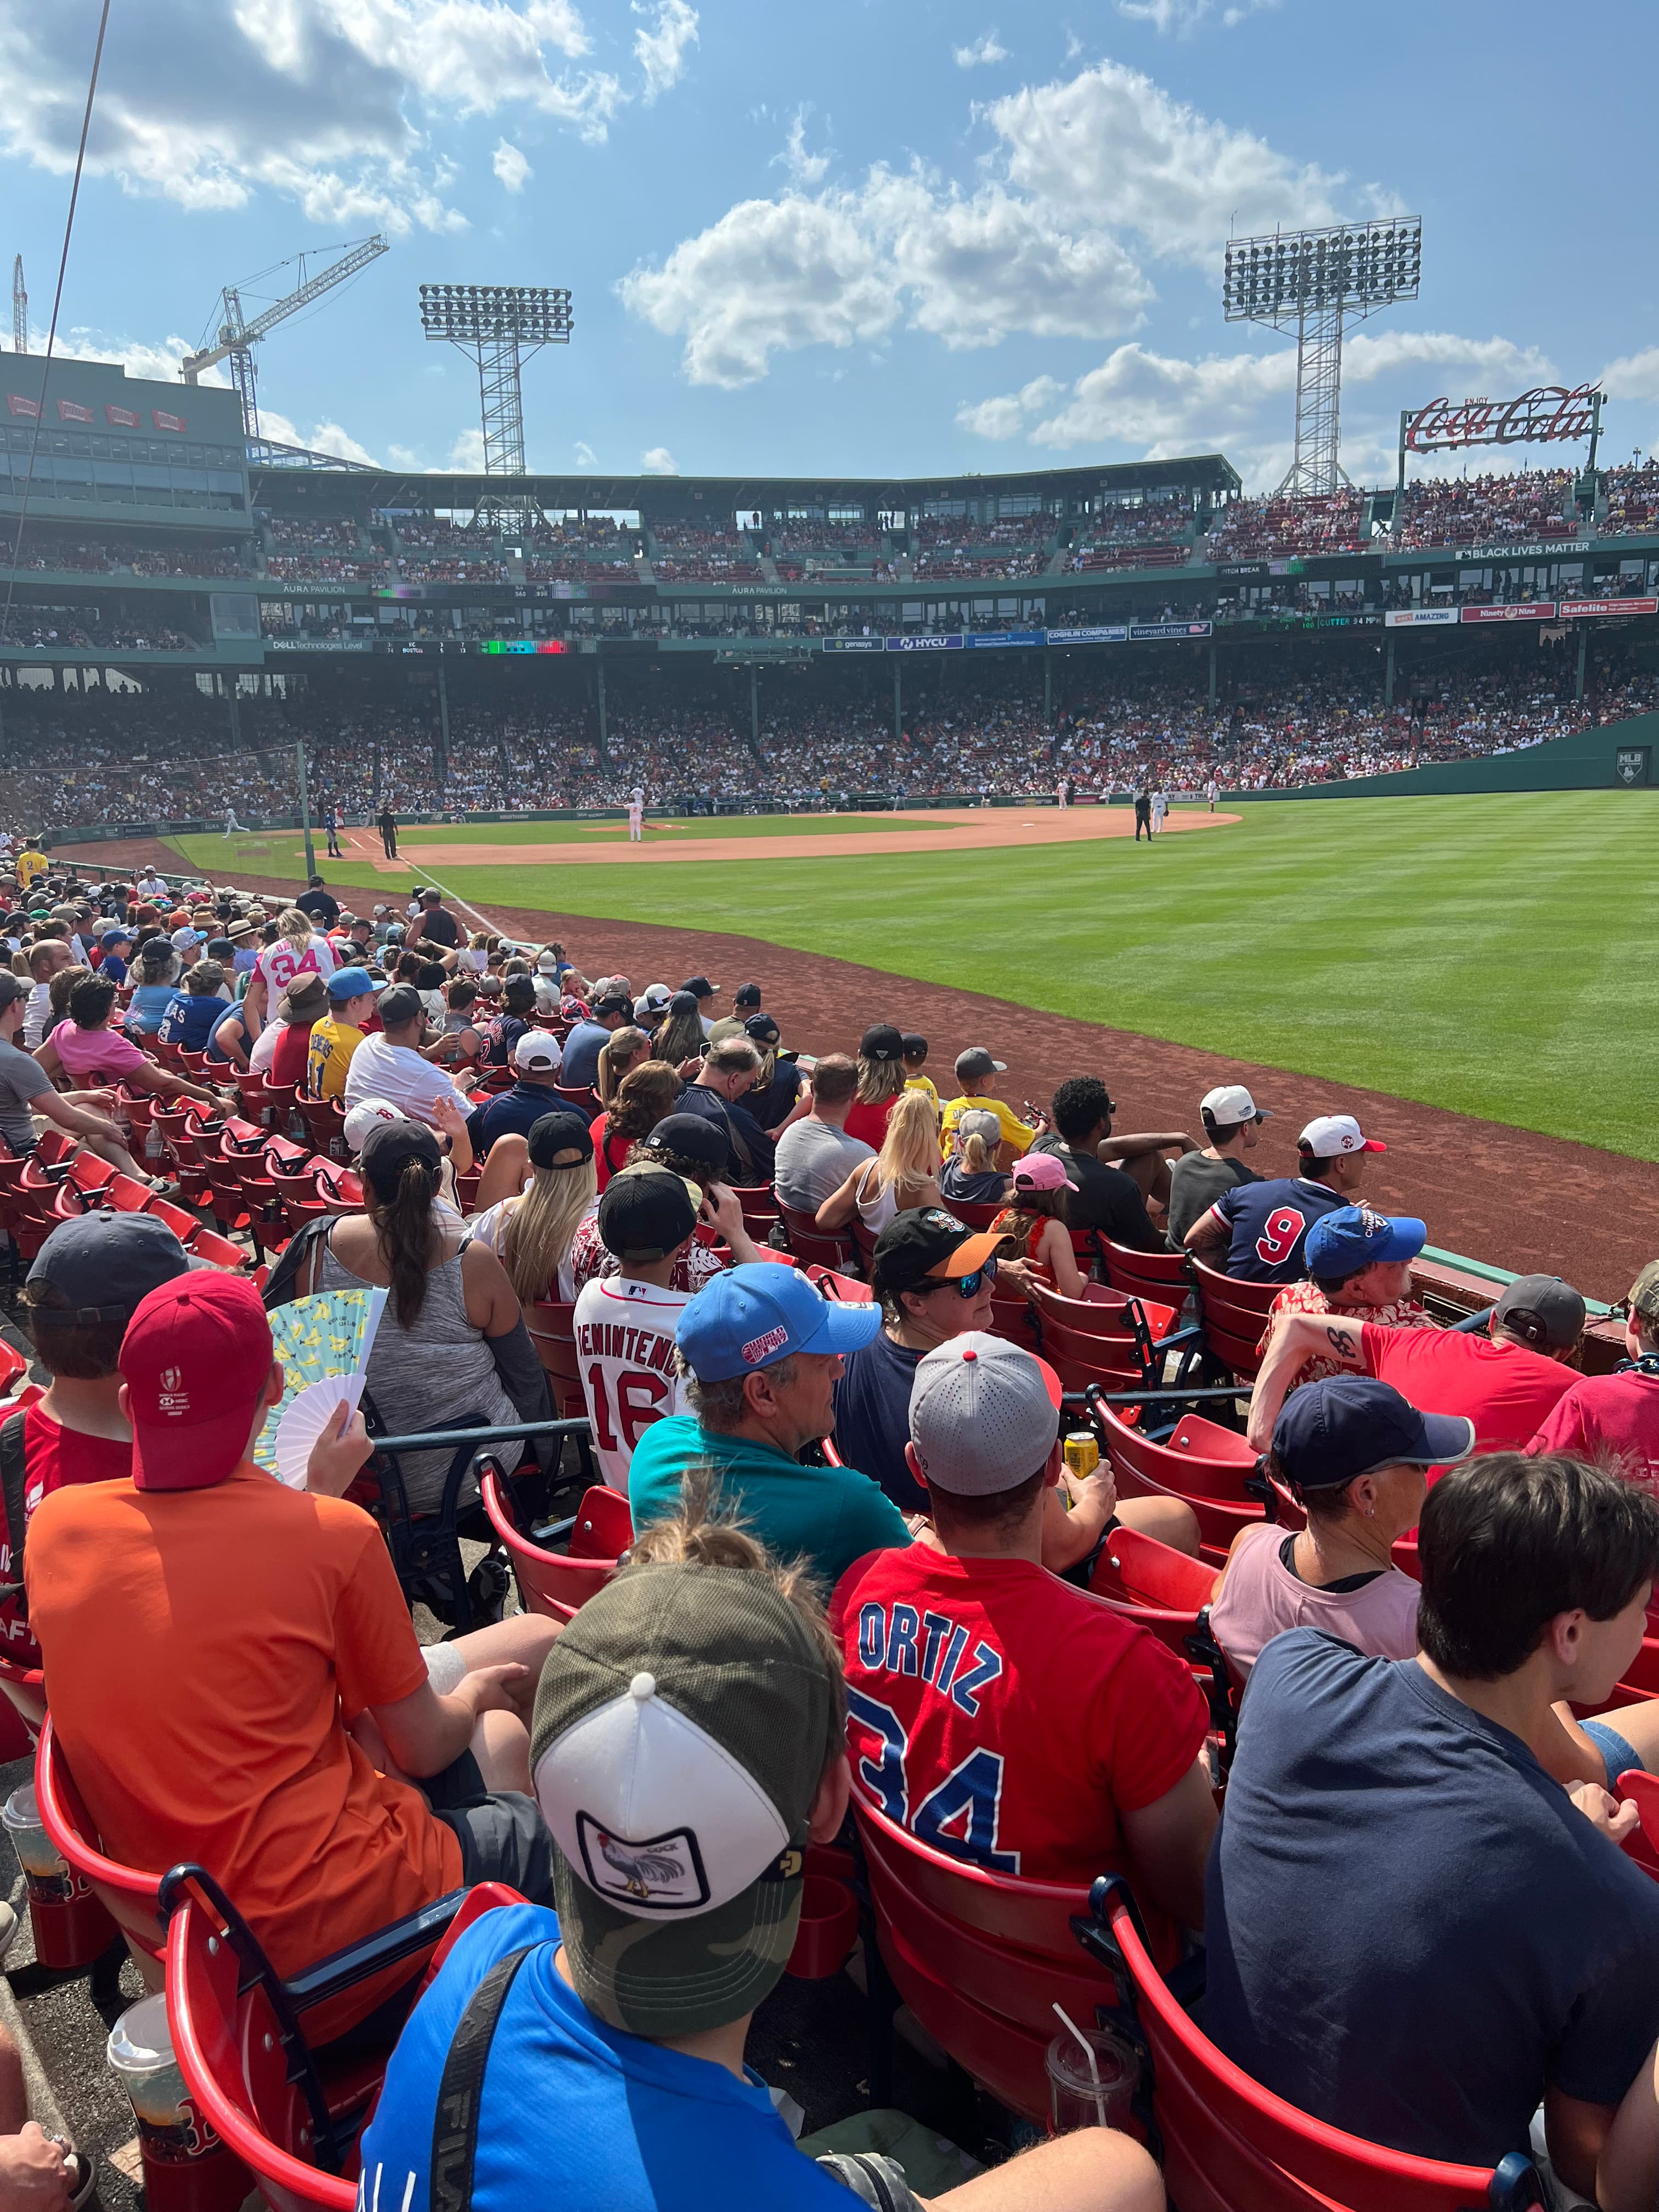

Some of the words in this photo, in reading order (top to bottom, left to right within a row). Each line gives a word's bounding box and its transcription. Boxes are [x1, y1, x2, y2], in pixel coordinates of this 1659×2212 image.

[1464, 397, 1488, 407] ENJOY
[1472, 548, 1509, 558] BLACK
[1511, 545, 1543, 556] LIVES
[1545, 542, 1589, 554] MATTER
[1480, 610, 1504, 618] Ninety
[1562, 603, 1607, 614] Safelite
[1320, 618, 1350, 627] CUTTER
[1415, 613, 1449, 621] AMAZING
[1049, 630, 1081, 639] COGHLIN
[1081, 628, 1125, 637] COMPANIES
[1132, 627, 1166, 636] vineyard
[296, 641, 342, 650] Technologies
[916, 639, 946, 647] HYCU
[1619, 753, 1641, 763] MLB
[26, 860, 34, 871] 2
[270, 949, 322, 988] 34
[1255, 1205, 1306, 1266] 9
[588, 1362, 669, 1454] 16
[859, 1601, 1003, 1718] ORTIZ
[845, 1683, 1021, 1876] 34
